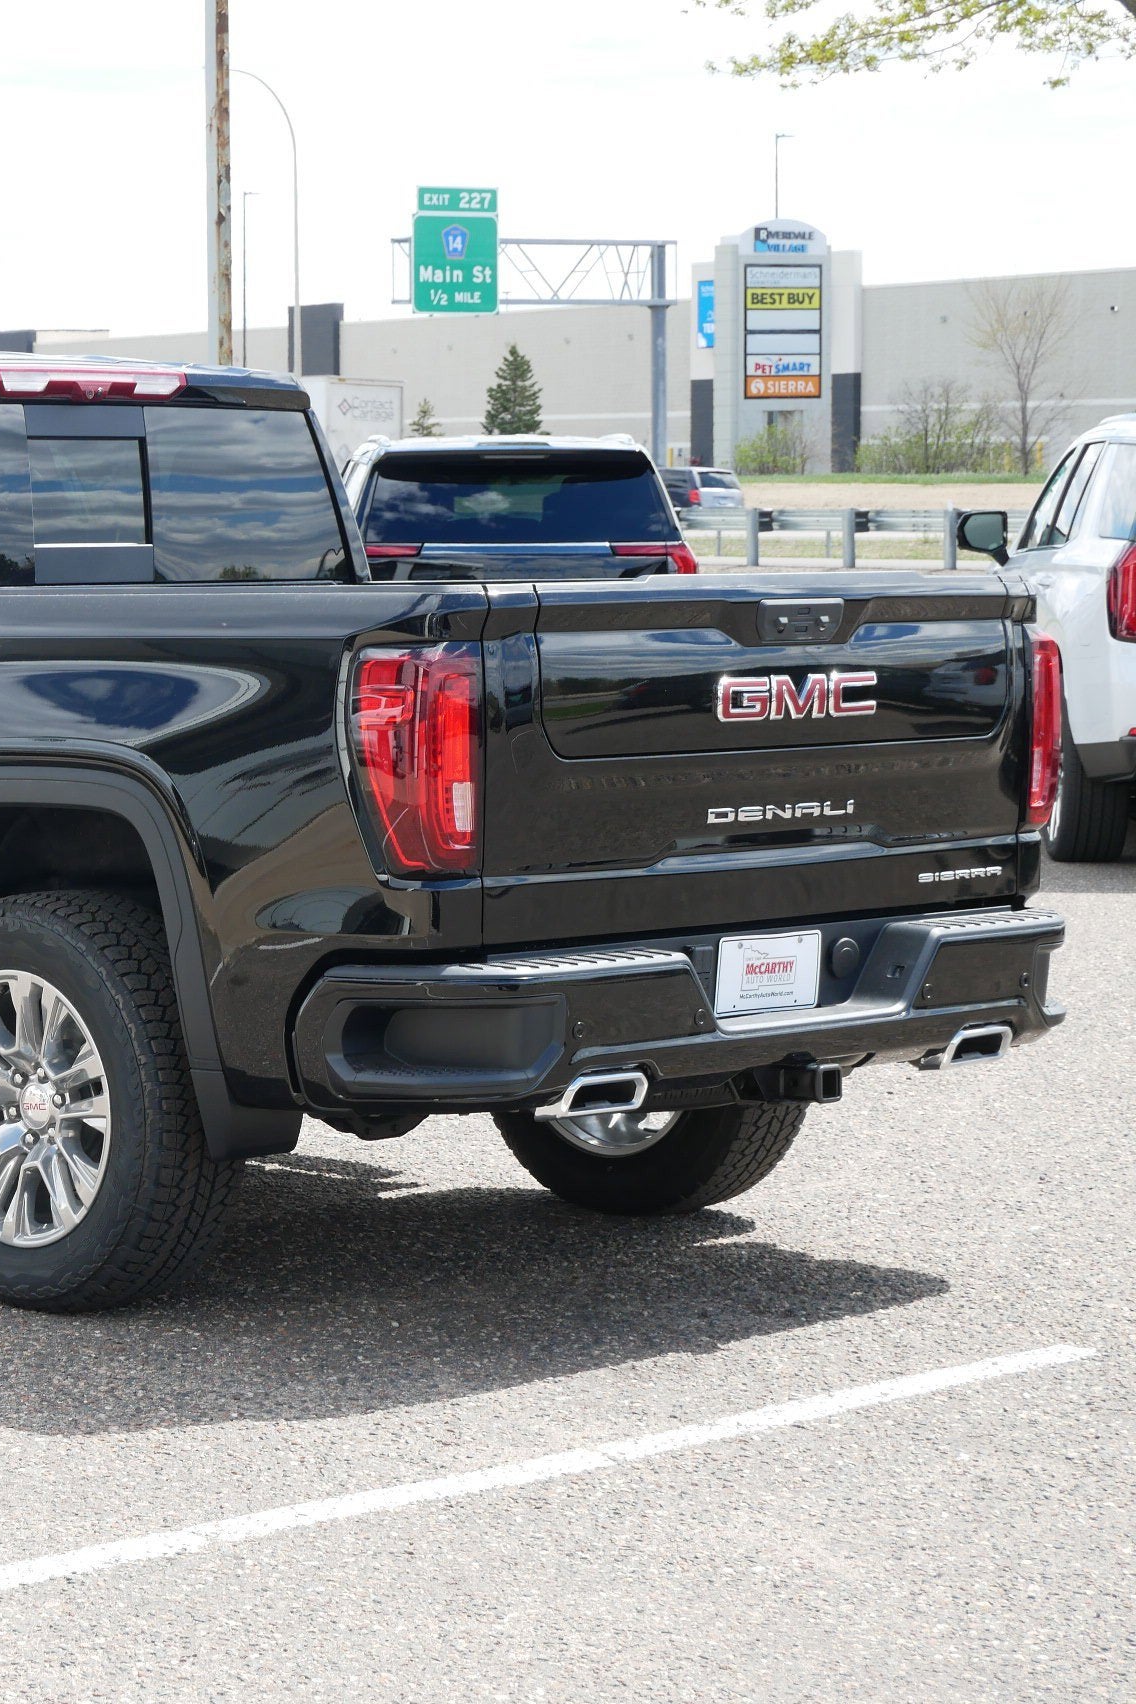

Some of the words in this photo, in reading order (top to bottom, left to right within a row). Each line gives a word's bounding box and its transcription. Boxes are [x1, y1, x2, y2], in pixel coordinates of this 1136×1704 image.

[423, 193, 450, 206] EXIT
[459, 192, 492, 209] 227
[448, 235, 462, 252] 14
[767, 243, 808, 253] VILLAGE
[419, 265, 463, 283] Main
[472, 265, 492, 283] St
[454, 291, 482, 303] MILE
[751, 292, 784, 305] BEST
[787, 292, 816, 305] BUY
[767, 380, 815, 394] SIERRA
[716, 669, 878, 723] GMC
[706, 799, 855, 825] DENALI
[917, 865, 1003, 883] SIERRA
[745, 960, 795, 976] McCARTHY
[746, 974, 764, 985] AUTO
[766, 973, 791, 983] WORLD
[23, 1102, 47, 1111] GMC
